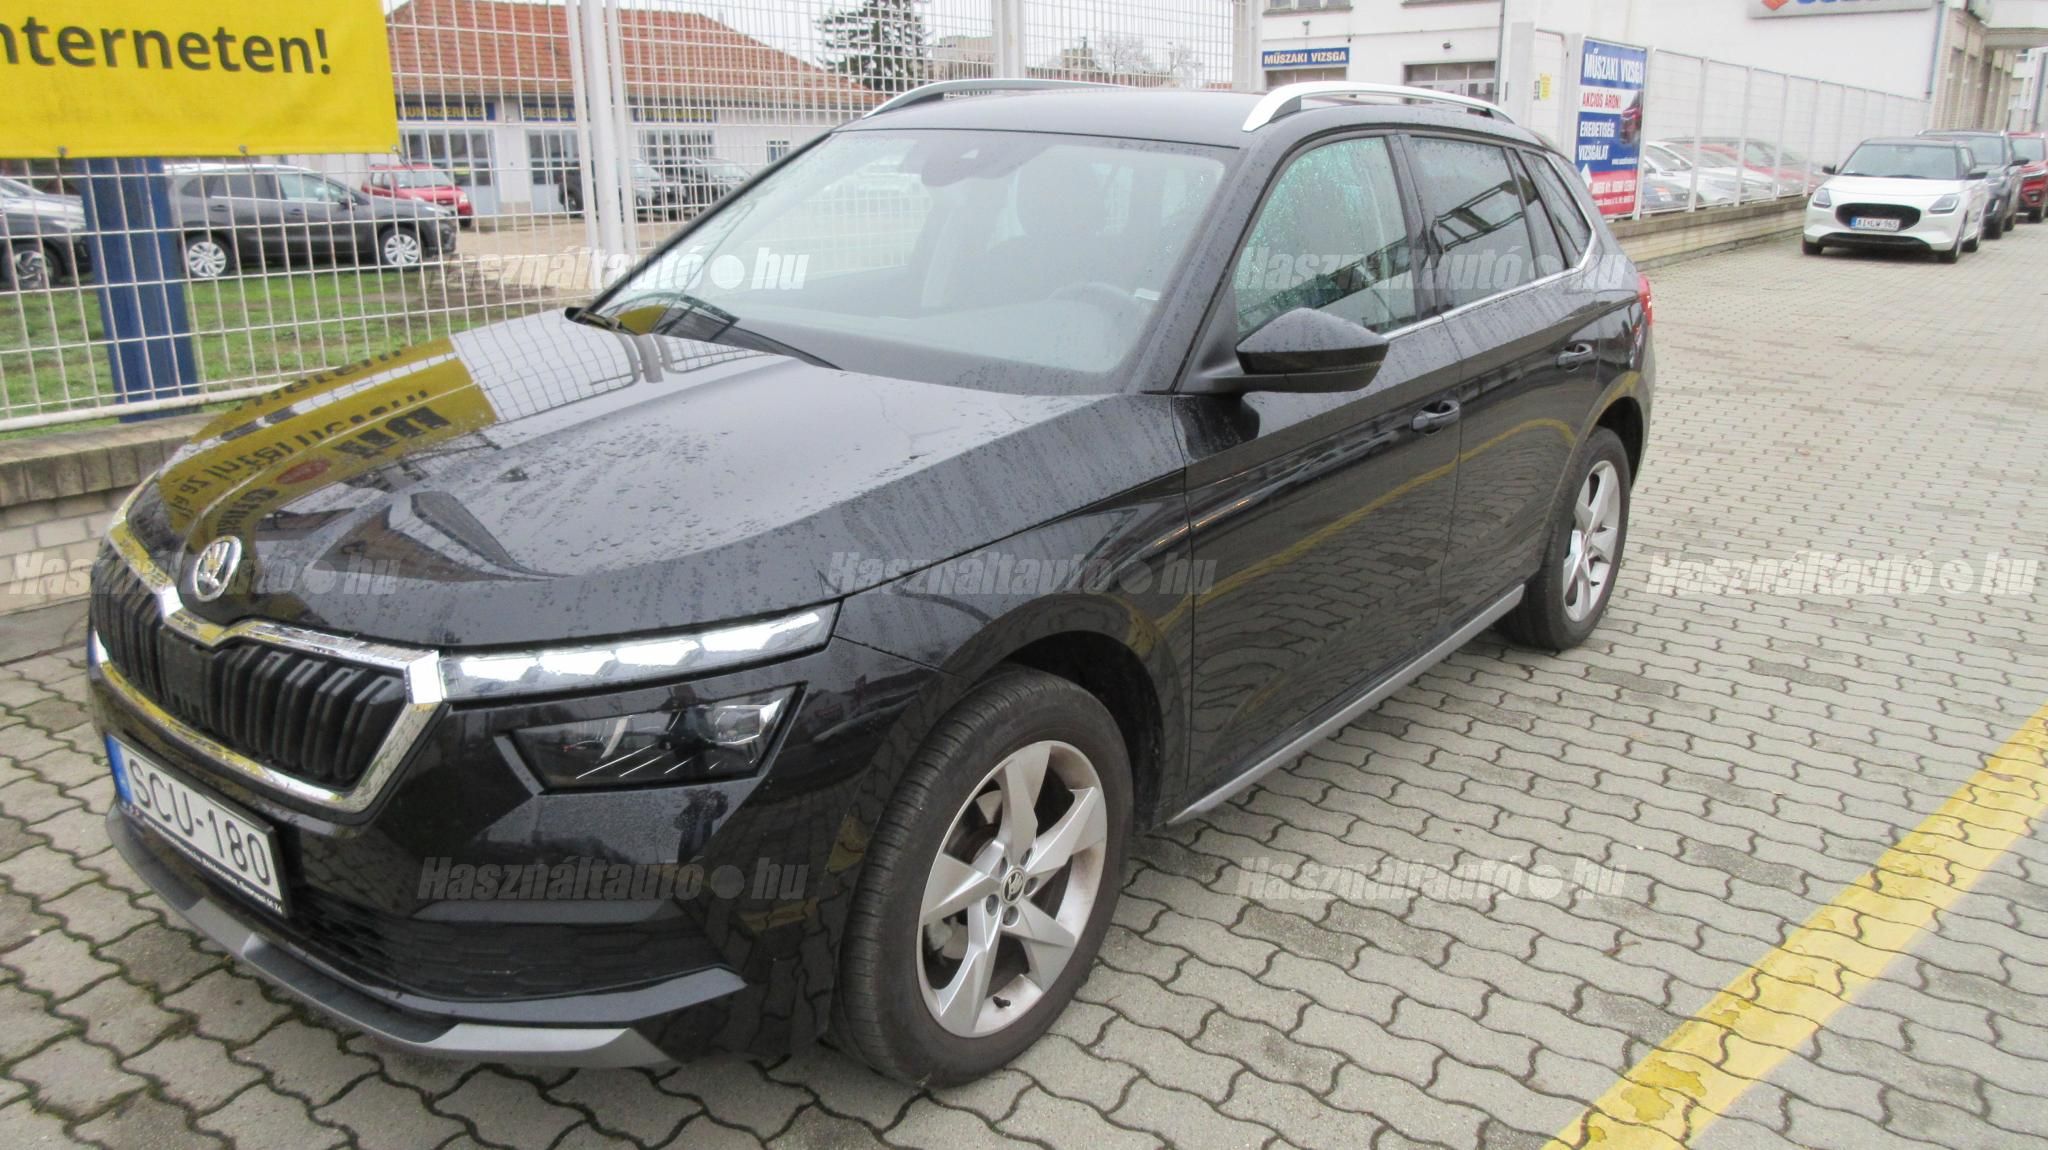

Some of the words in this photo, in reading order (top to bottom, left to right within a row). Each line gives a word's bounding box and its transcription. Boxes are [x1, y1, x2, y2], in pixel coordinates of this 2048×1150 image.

[1264, 51, 1307, 65] MŰSZAKI
[1311, 51, 1346, 62] VIZSGA
[1584, 48, 1618, 80] MŰSZAKI
[1578, 141, 1609, 160] VIZSGÁLAT
[129, 758, 271, 886] SCU-180
